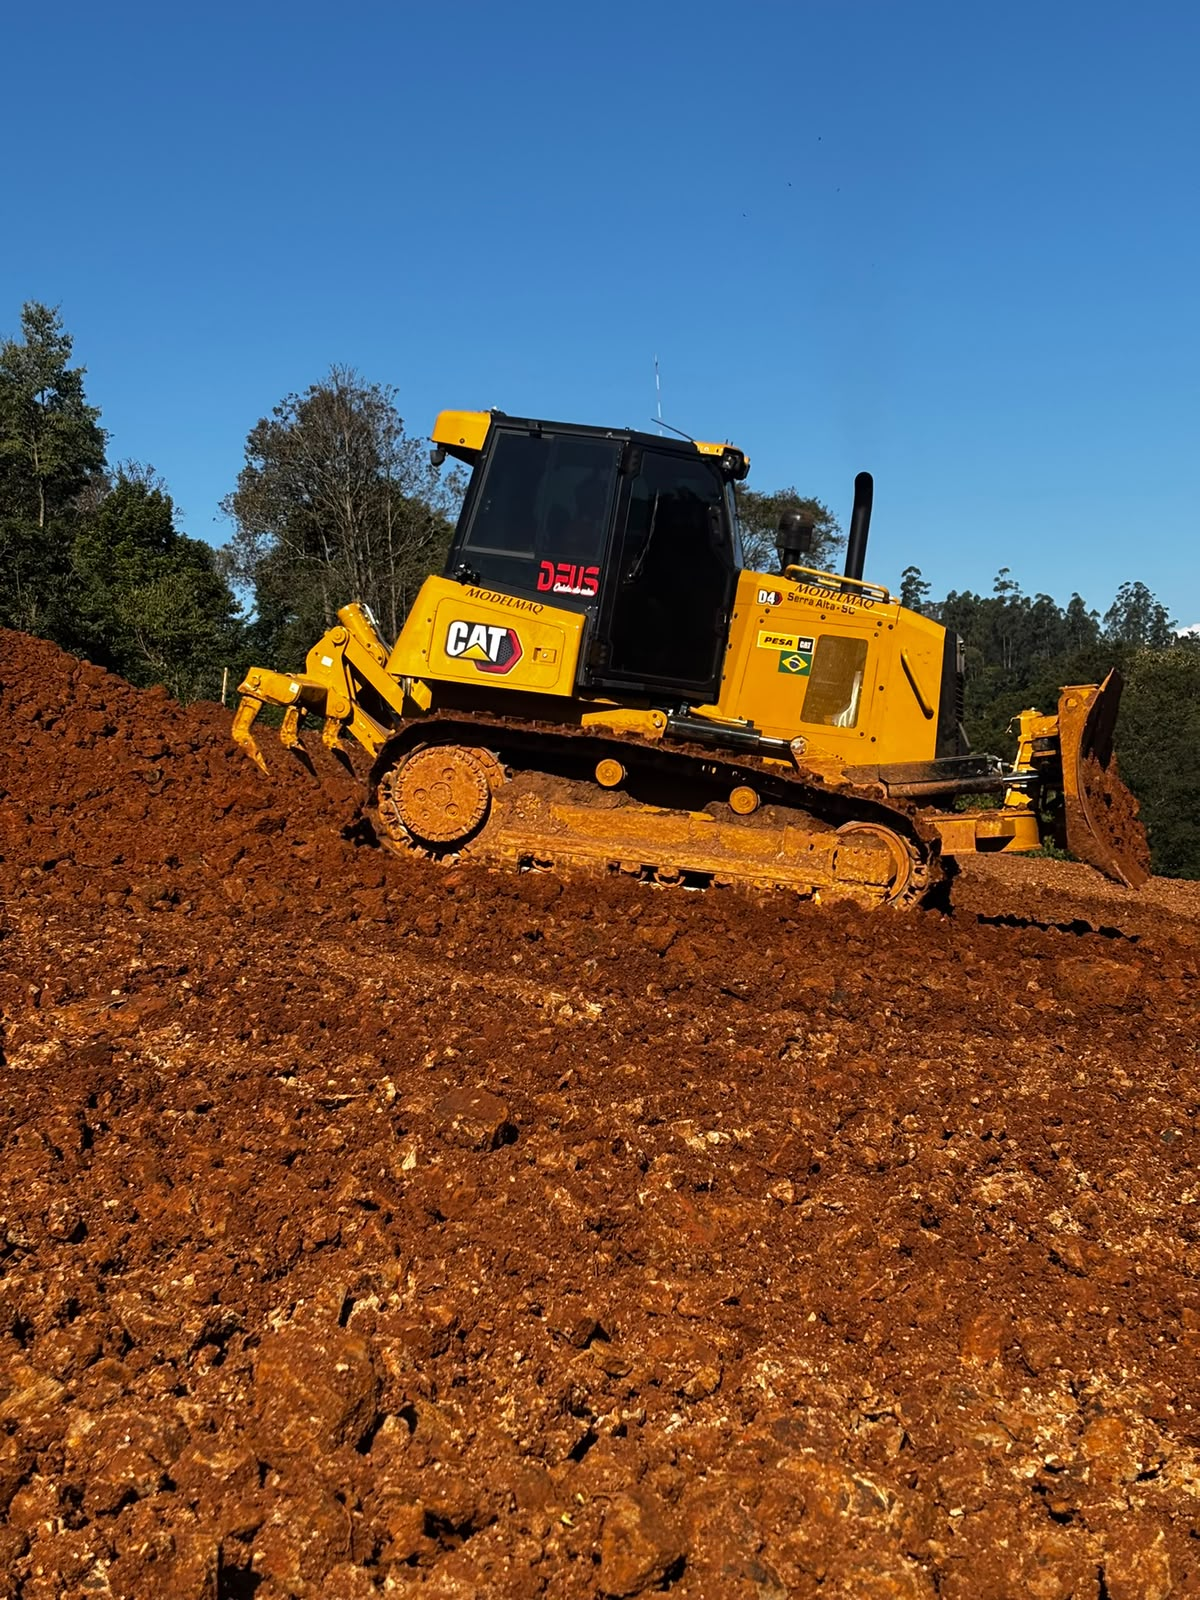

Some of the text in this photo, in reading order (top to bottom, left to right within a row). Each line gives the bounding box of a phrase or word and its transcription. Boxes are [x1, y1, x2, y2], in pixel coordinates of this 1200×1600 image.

[537, 560, 600, 597] DEUS
[466, 588, 544, 615] MODELMAQ
[757, 590, 776, 605] D4
[787, 592, 814, 606] Serra
[815, 599, 836, 611] Alta
[841, 605, 856, 615] SC
[795, 584, 875, 610] MODELMAQ
[446, 621, 507, 662] CAT
[764, 636, 812, 650] PESA CAT
